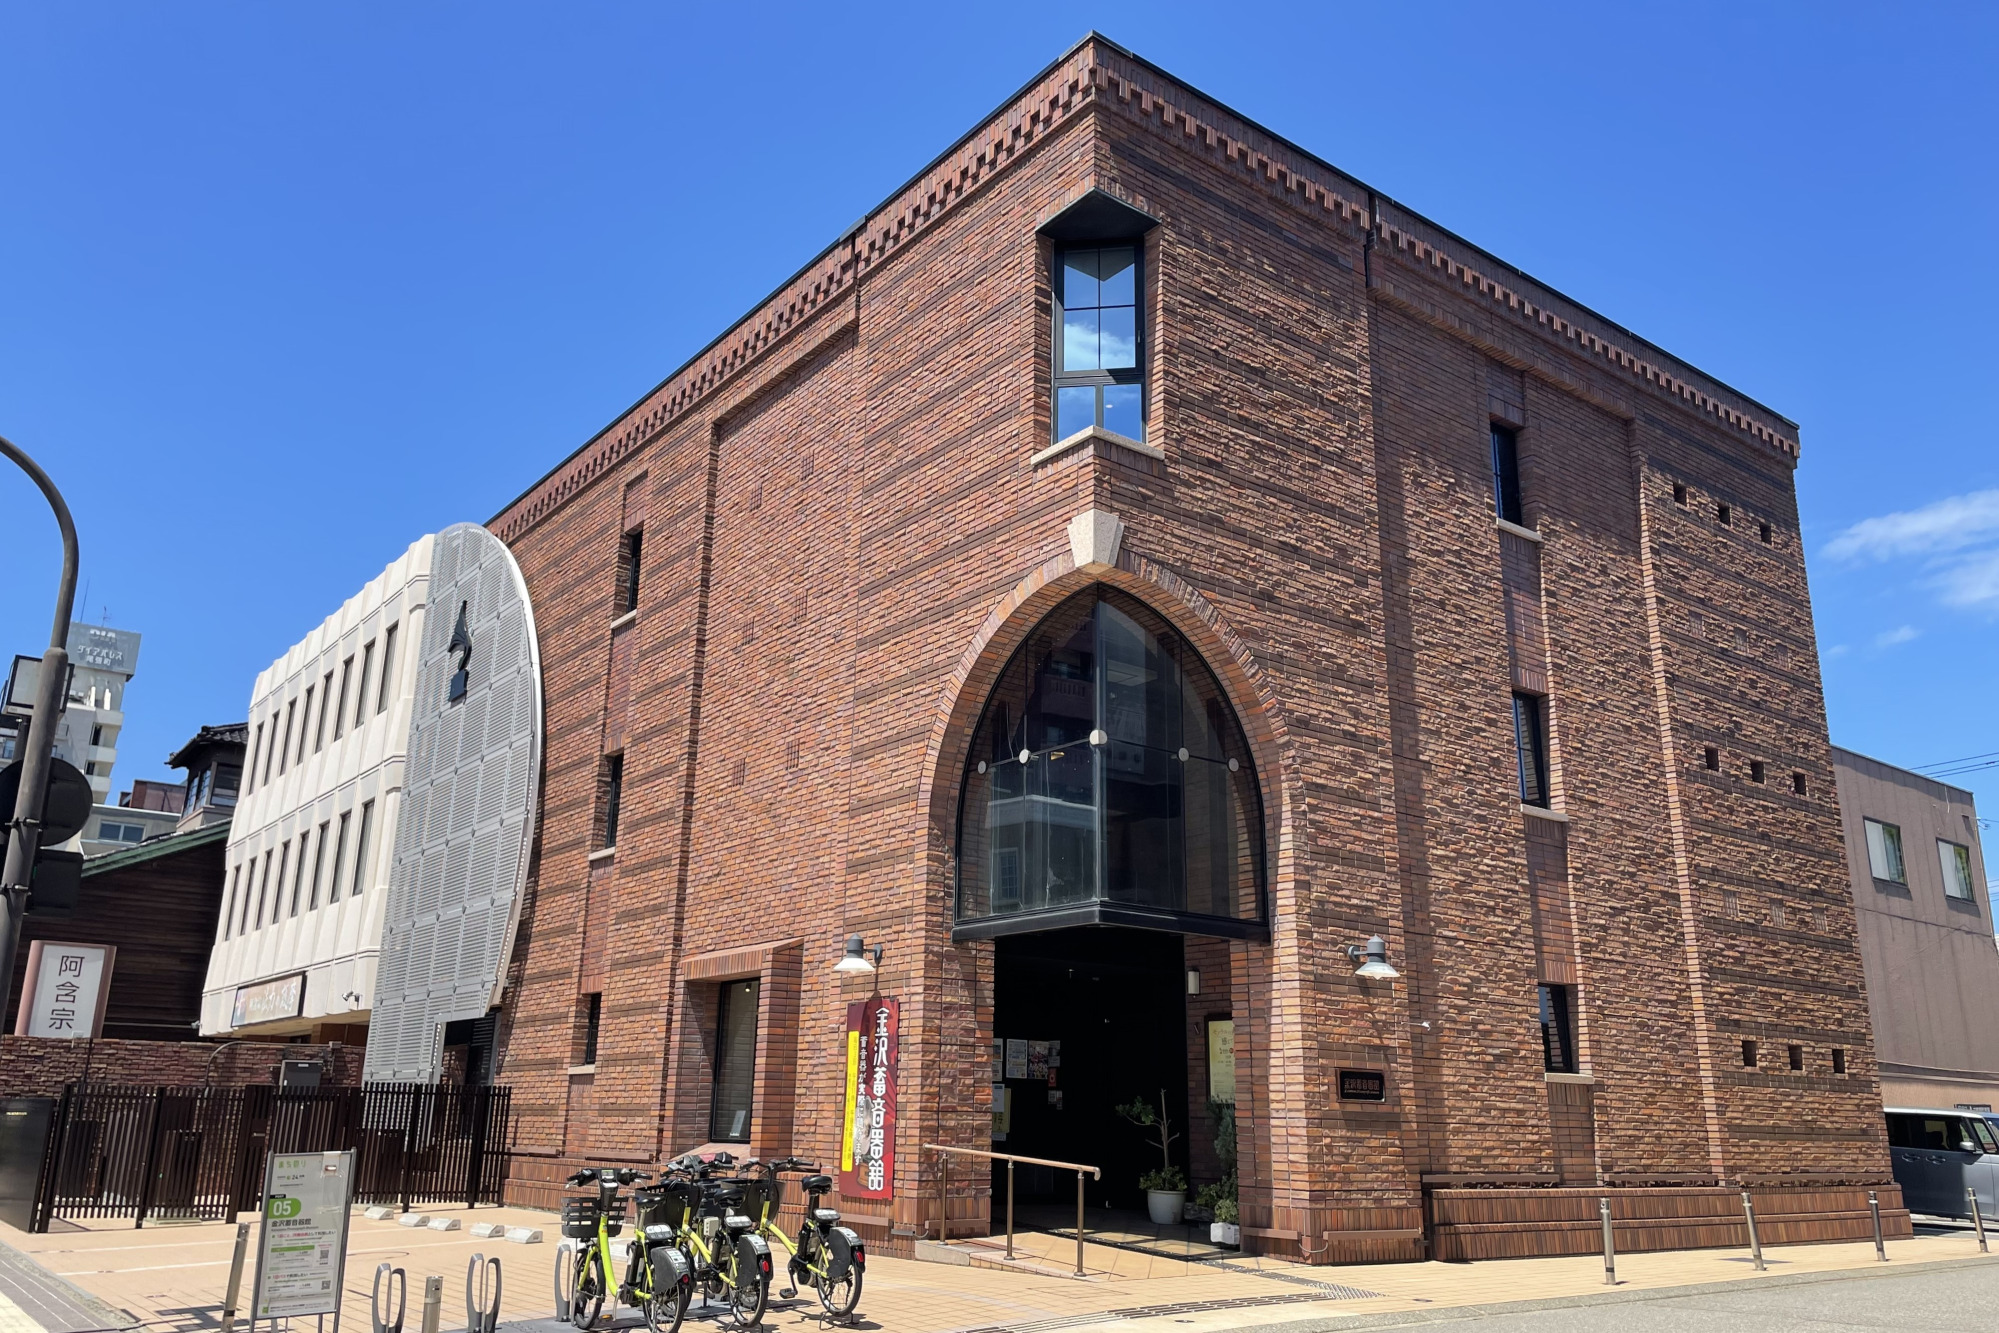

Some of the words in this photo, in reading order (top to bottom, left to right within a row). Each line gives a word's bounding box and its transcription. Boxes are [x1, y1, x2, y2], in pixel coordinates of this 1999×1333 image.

[77, 645, 123, 660] ダイアパレス
[48, 955, 85, 1030] 阿含宗
[868, 1007, 890, 1191] 金沢蓄音器館
[273, 1201, 291, 1215] 05
